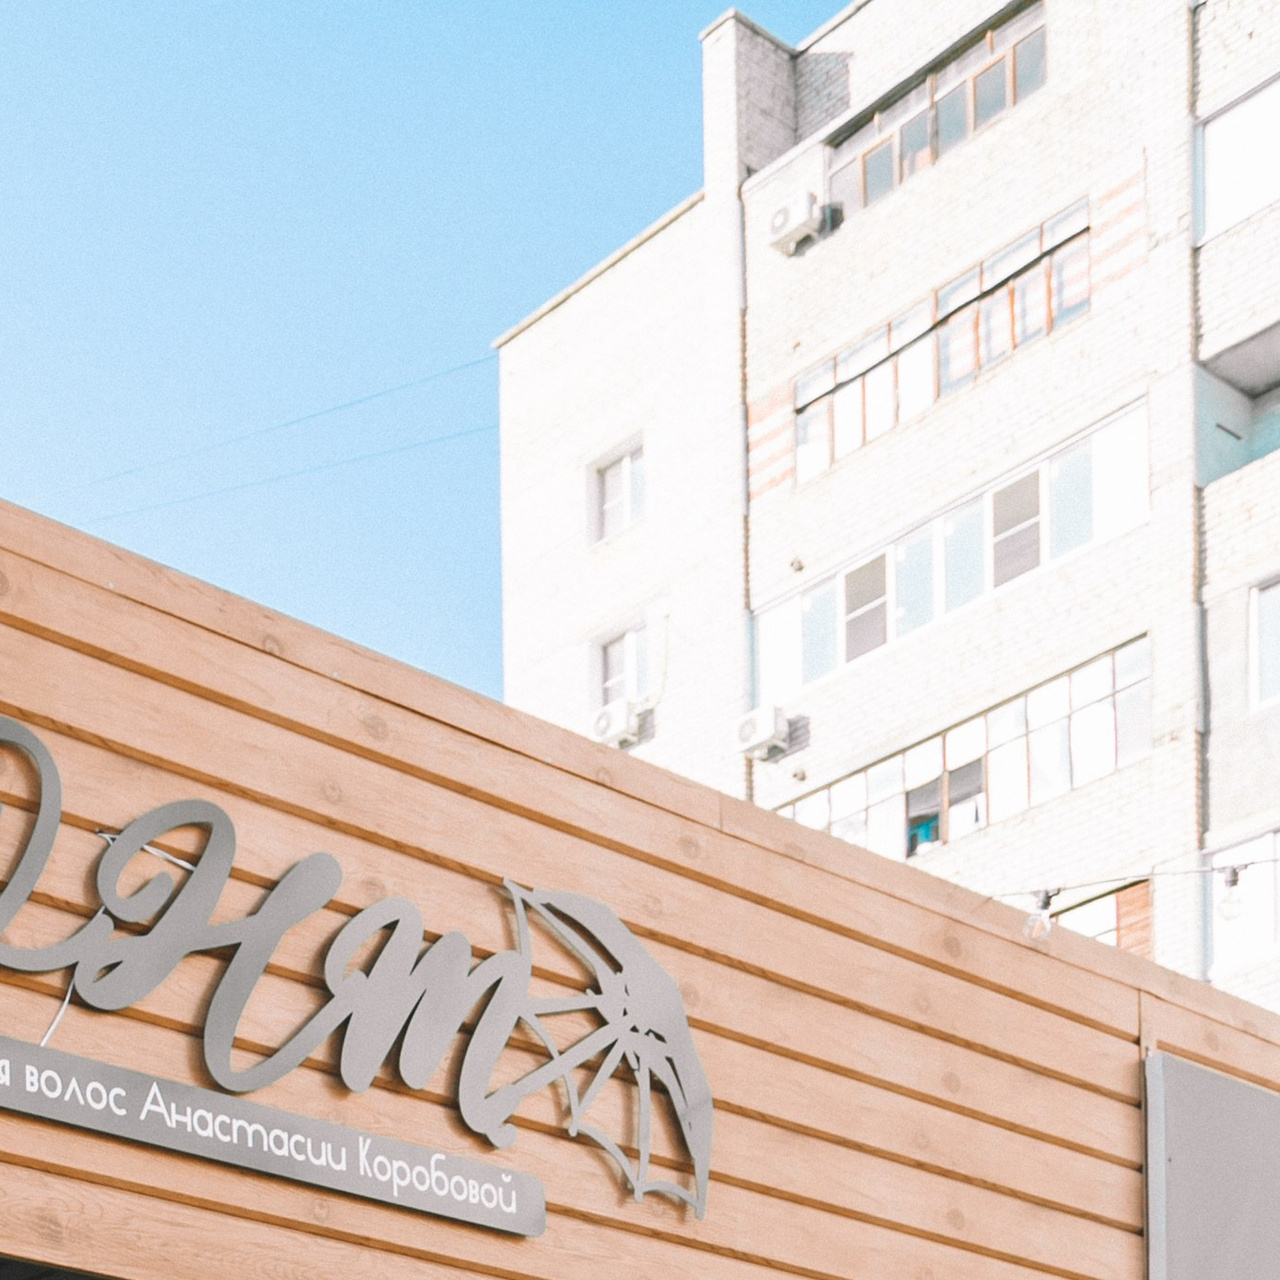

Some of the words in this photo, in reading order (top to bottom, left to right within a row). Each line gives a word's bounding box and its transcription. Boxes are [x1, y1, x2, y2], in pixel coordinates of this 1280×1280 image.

[25, 1064, 128, 1117] волос
[139, 1080, 348, 1172] Анастасии
[357, 1136, 518, 1215] Коробовой
